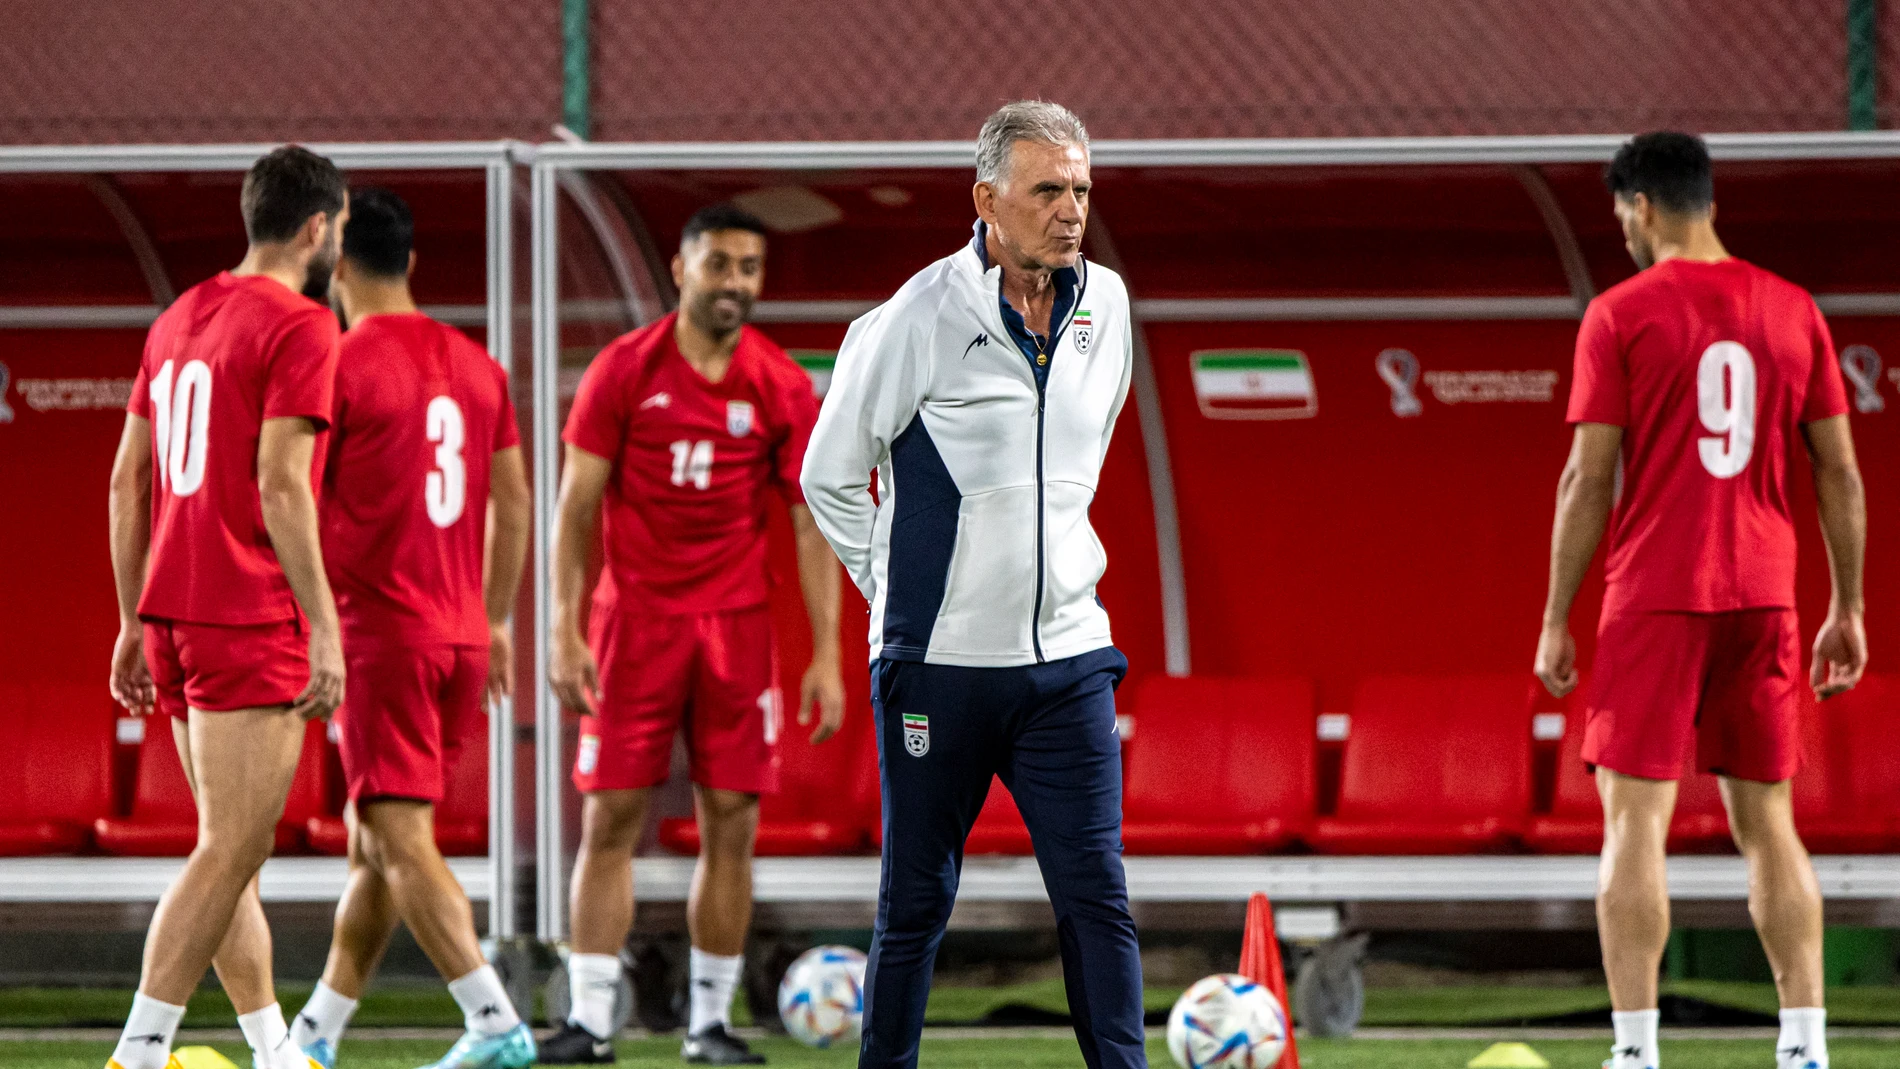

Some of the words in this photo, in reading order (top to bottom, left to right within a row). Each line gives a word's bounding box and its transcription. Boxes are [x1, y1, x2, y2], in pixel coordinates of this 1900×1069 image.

[149, 359, 213, 497] 10
[425, 395, 467, 528] 3
[670, 440, 715, 491] 14
[1697, 340, 1758, 479] 9
